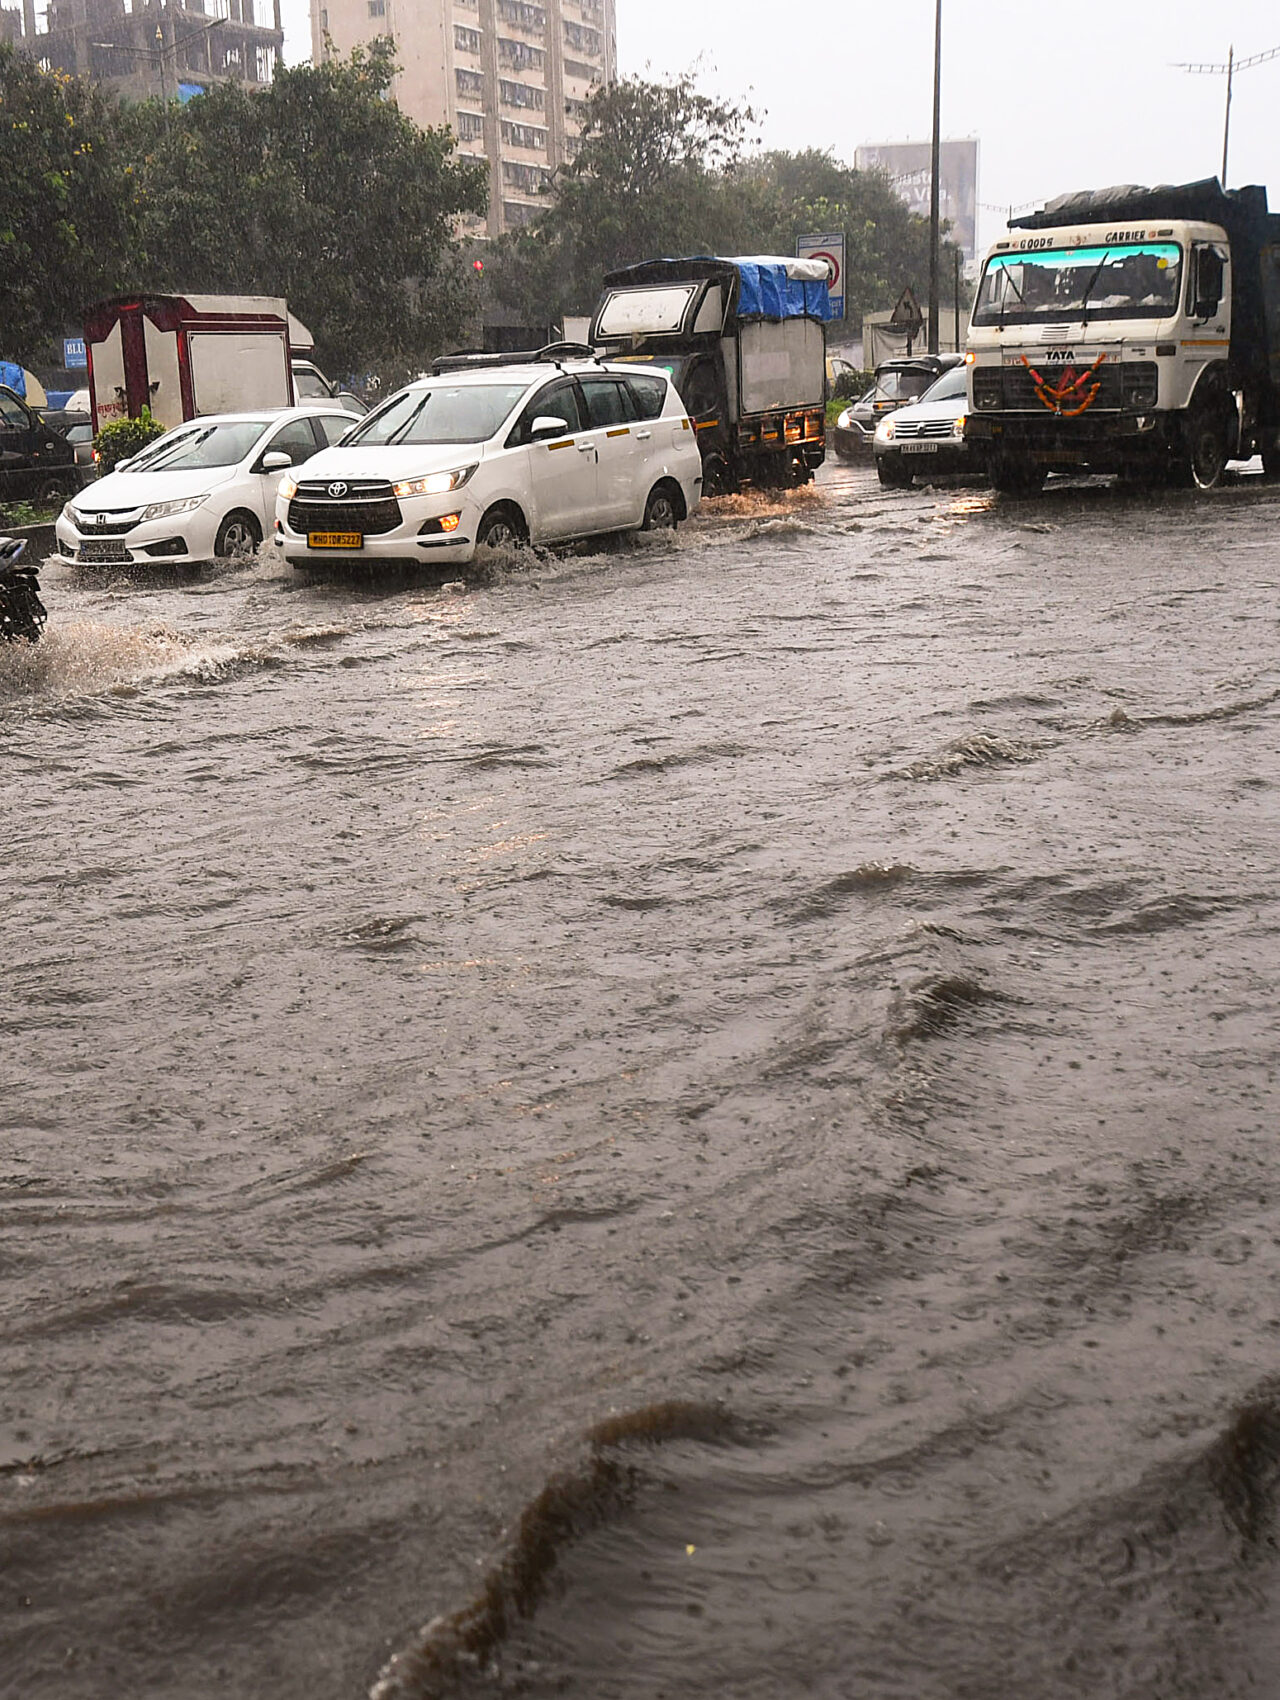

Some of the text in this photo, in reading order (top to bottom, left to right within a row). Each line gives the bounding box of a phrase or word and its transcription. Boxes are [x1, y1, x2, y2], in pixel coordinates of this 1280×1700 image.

[1020, 237, 1054, 249] GOODS
[1105, 230, 1146, 243] CARRIER
[1045, 351, 1075, 360] TATA
